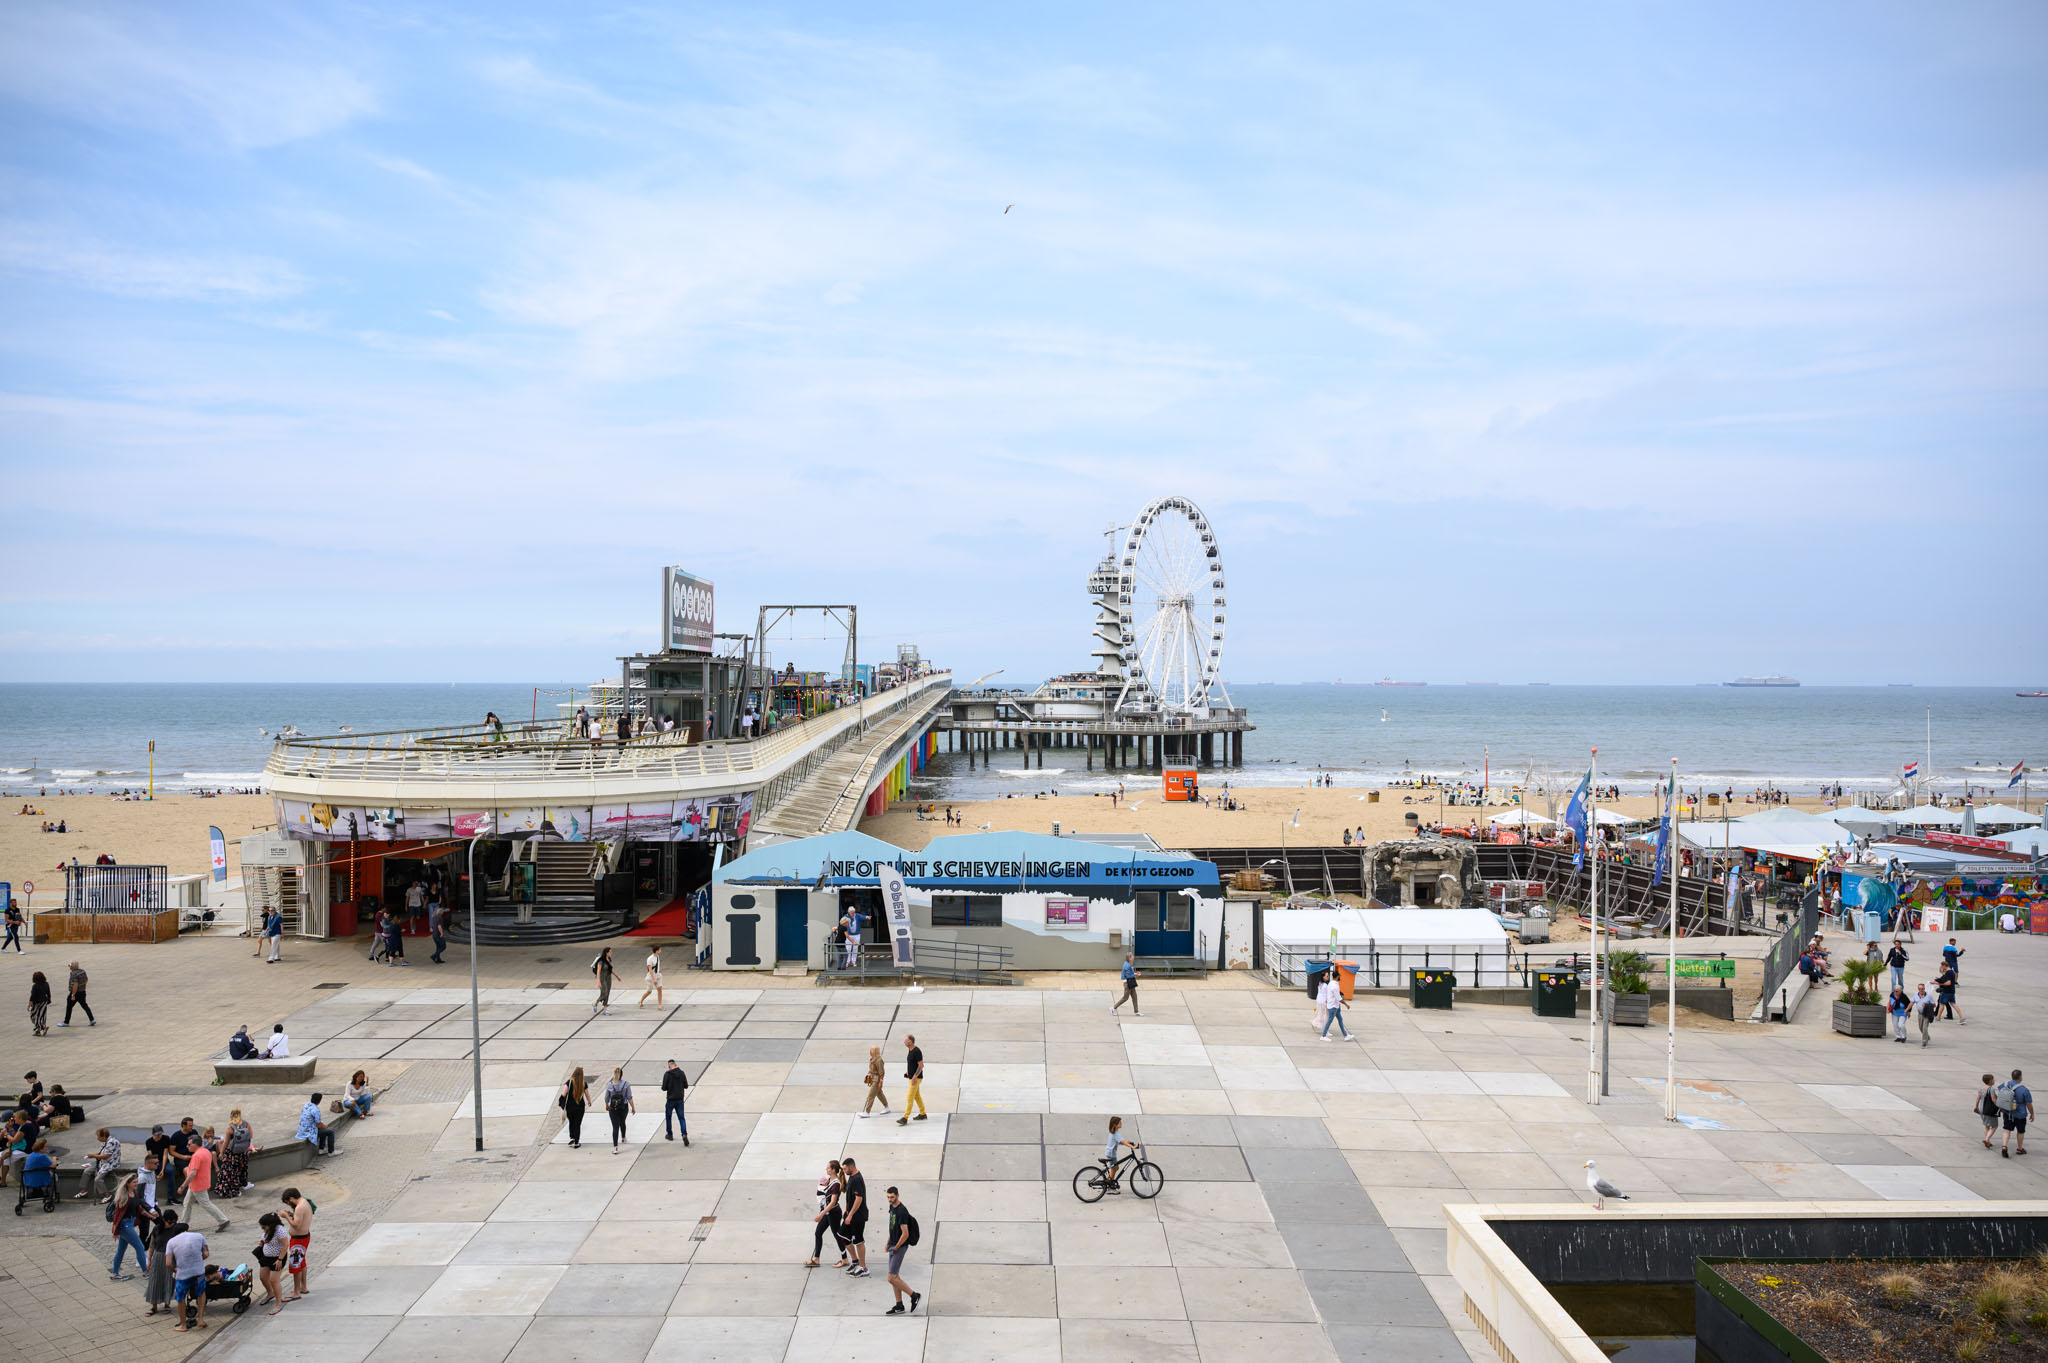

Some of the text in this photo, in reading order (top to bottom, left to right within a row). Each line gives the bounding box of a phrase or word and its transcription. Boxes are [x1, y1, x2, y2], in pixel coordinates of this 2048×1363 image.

[933, 861, 1090, 878] SCHEVENINGEN
[1105, 868, 1194, 876] DE KUST GEZOND
[1672, 961, 1711, 973] oiletten
